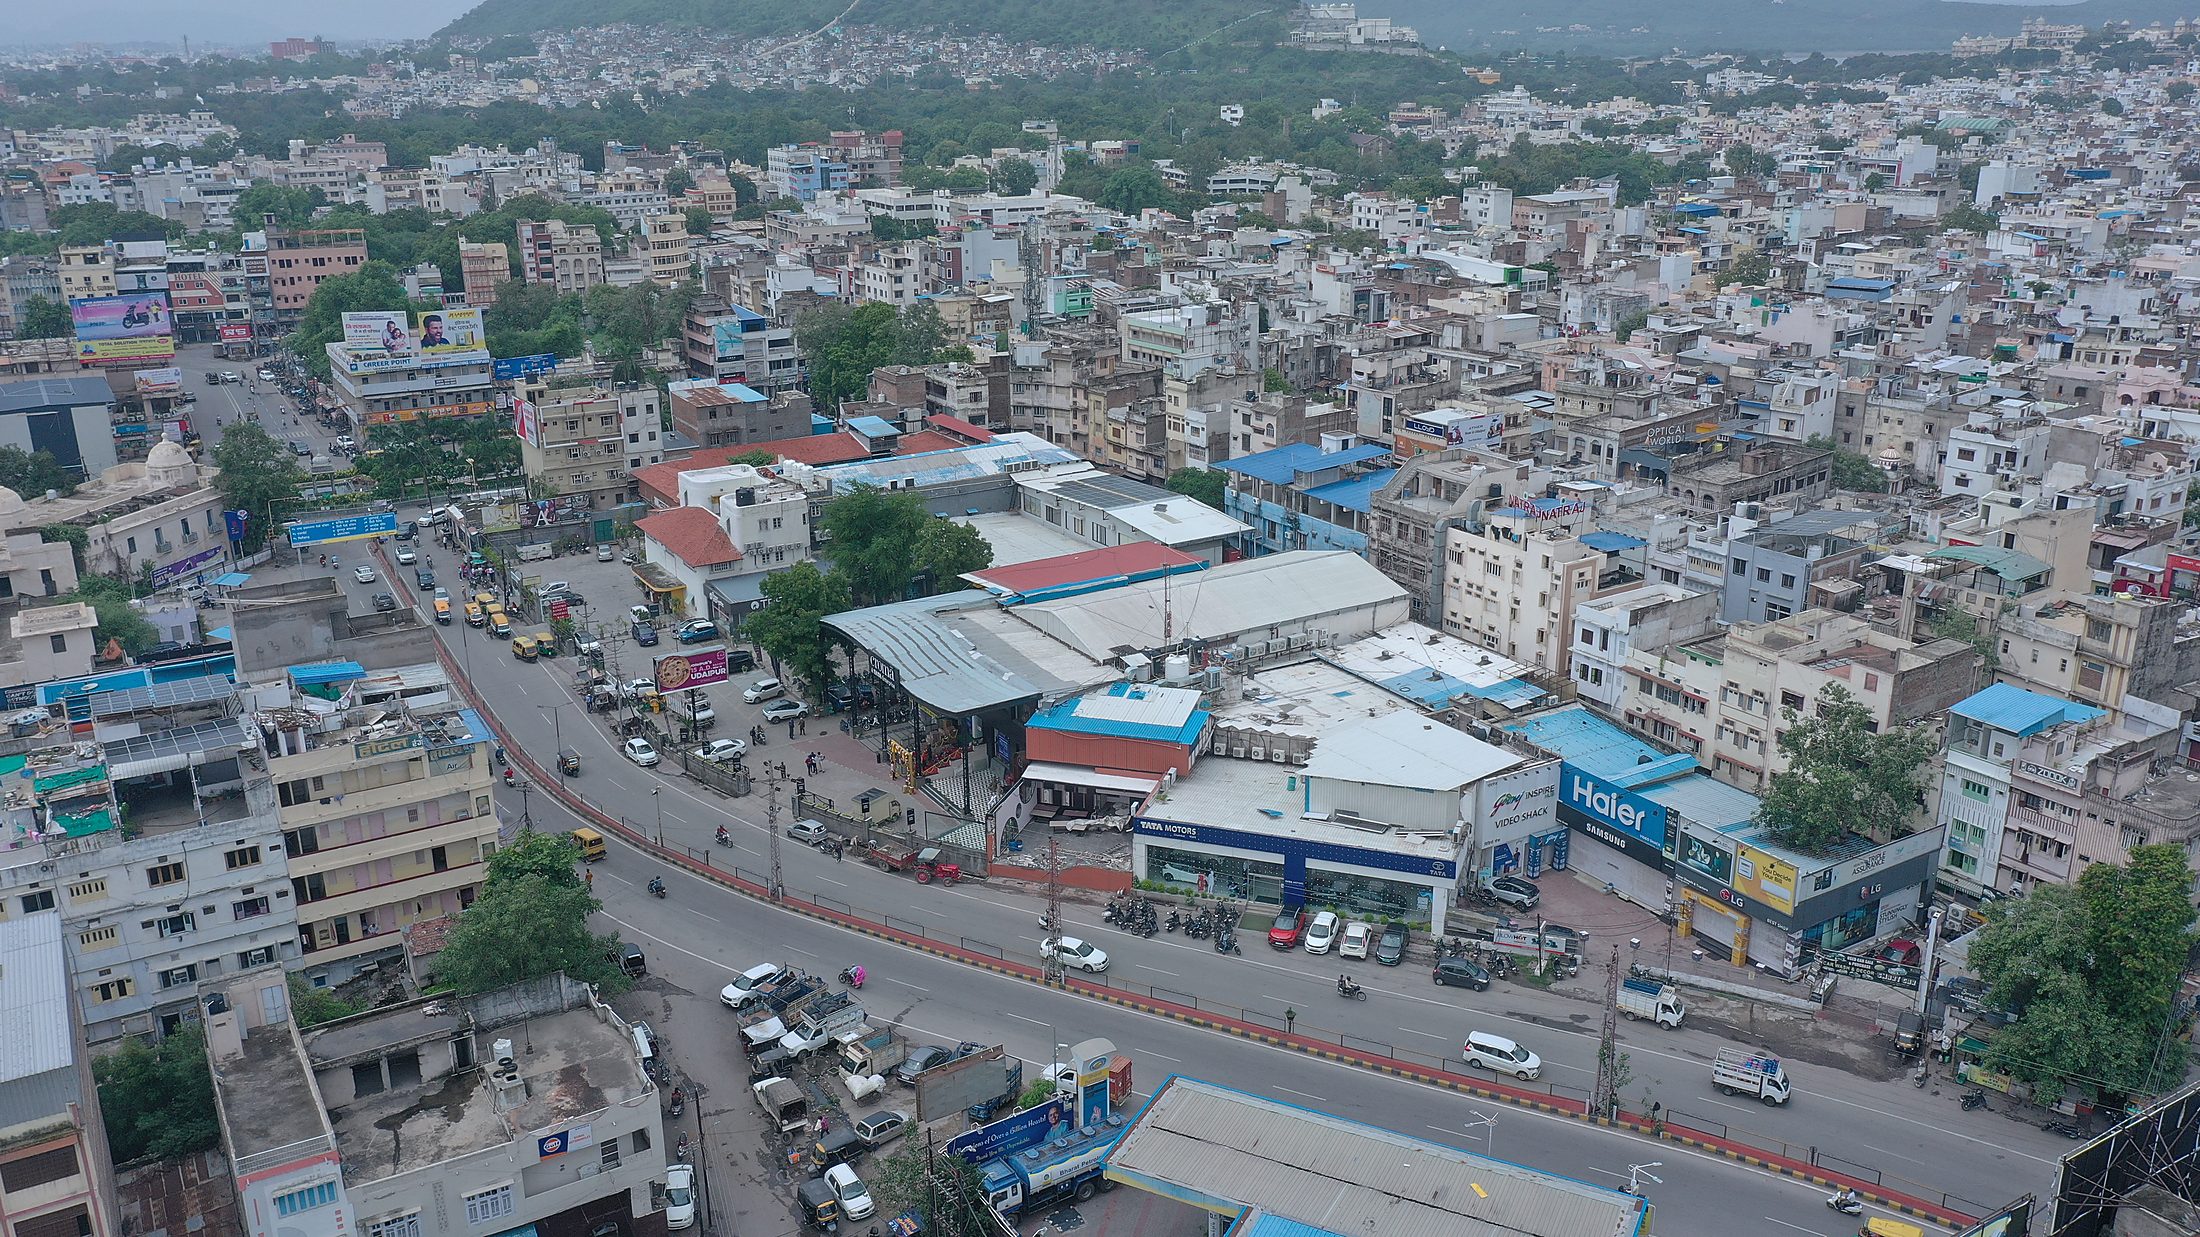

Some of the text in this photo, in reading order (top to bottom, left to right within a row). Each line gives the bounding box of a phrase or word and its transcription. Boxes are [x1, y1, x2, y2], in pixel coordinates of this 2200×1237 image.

[174, 273, 204, 281] HOTEL
[364, 360, 390, 368] CAREER
[1414, 423, 1435, 433] LLOYD
[1648, 424, 1685, 437] OPTICAL
[1650, 435, 1681, 445] WORLD
[1508, 494, 1540, 519] NATRAJ
[1542, 502, 1586, 520] NATRAJ
[691, 668, 726, 679] UDAIPUR
[1490, 784, 1555, 817] Godrej INSPIRE
[1573, 775, 1646, 831] Haier
[1495, 806, 1548, 828] VIDEO SHACK
[1140, 821, 1197, 835] TATA MOTORS
[1586, 823, 1626, 848] SAMSUNG
[1852, 859, 1886, 875] ASSURANCE
[1762, 872, 1773, 880] Your
[1773, 870, 1792, 882] Decide
[1871, 884, 1881, 894] LG
[1731, 894, 1744, 907] LG
[1880, 904, 1908, 918] STUNNINGLY
[991, 1133, 1005, 1142] Over
[1010, 1124, 1027, 1134] Billion
[1028, 1115, 1047, 1127] Hearts!
[1060, 1165, 1080, 1175] Bharat
